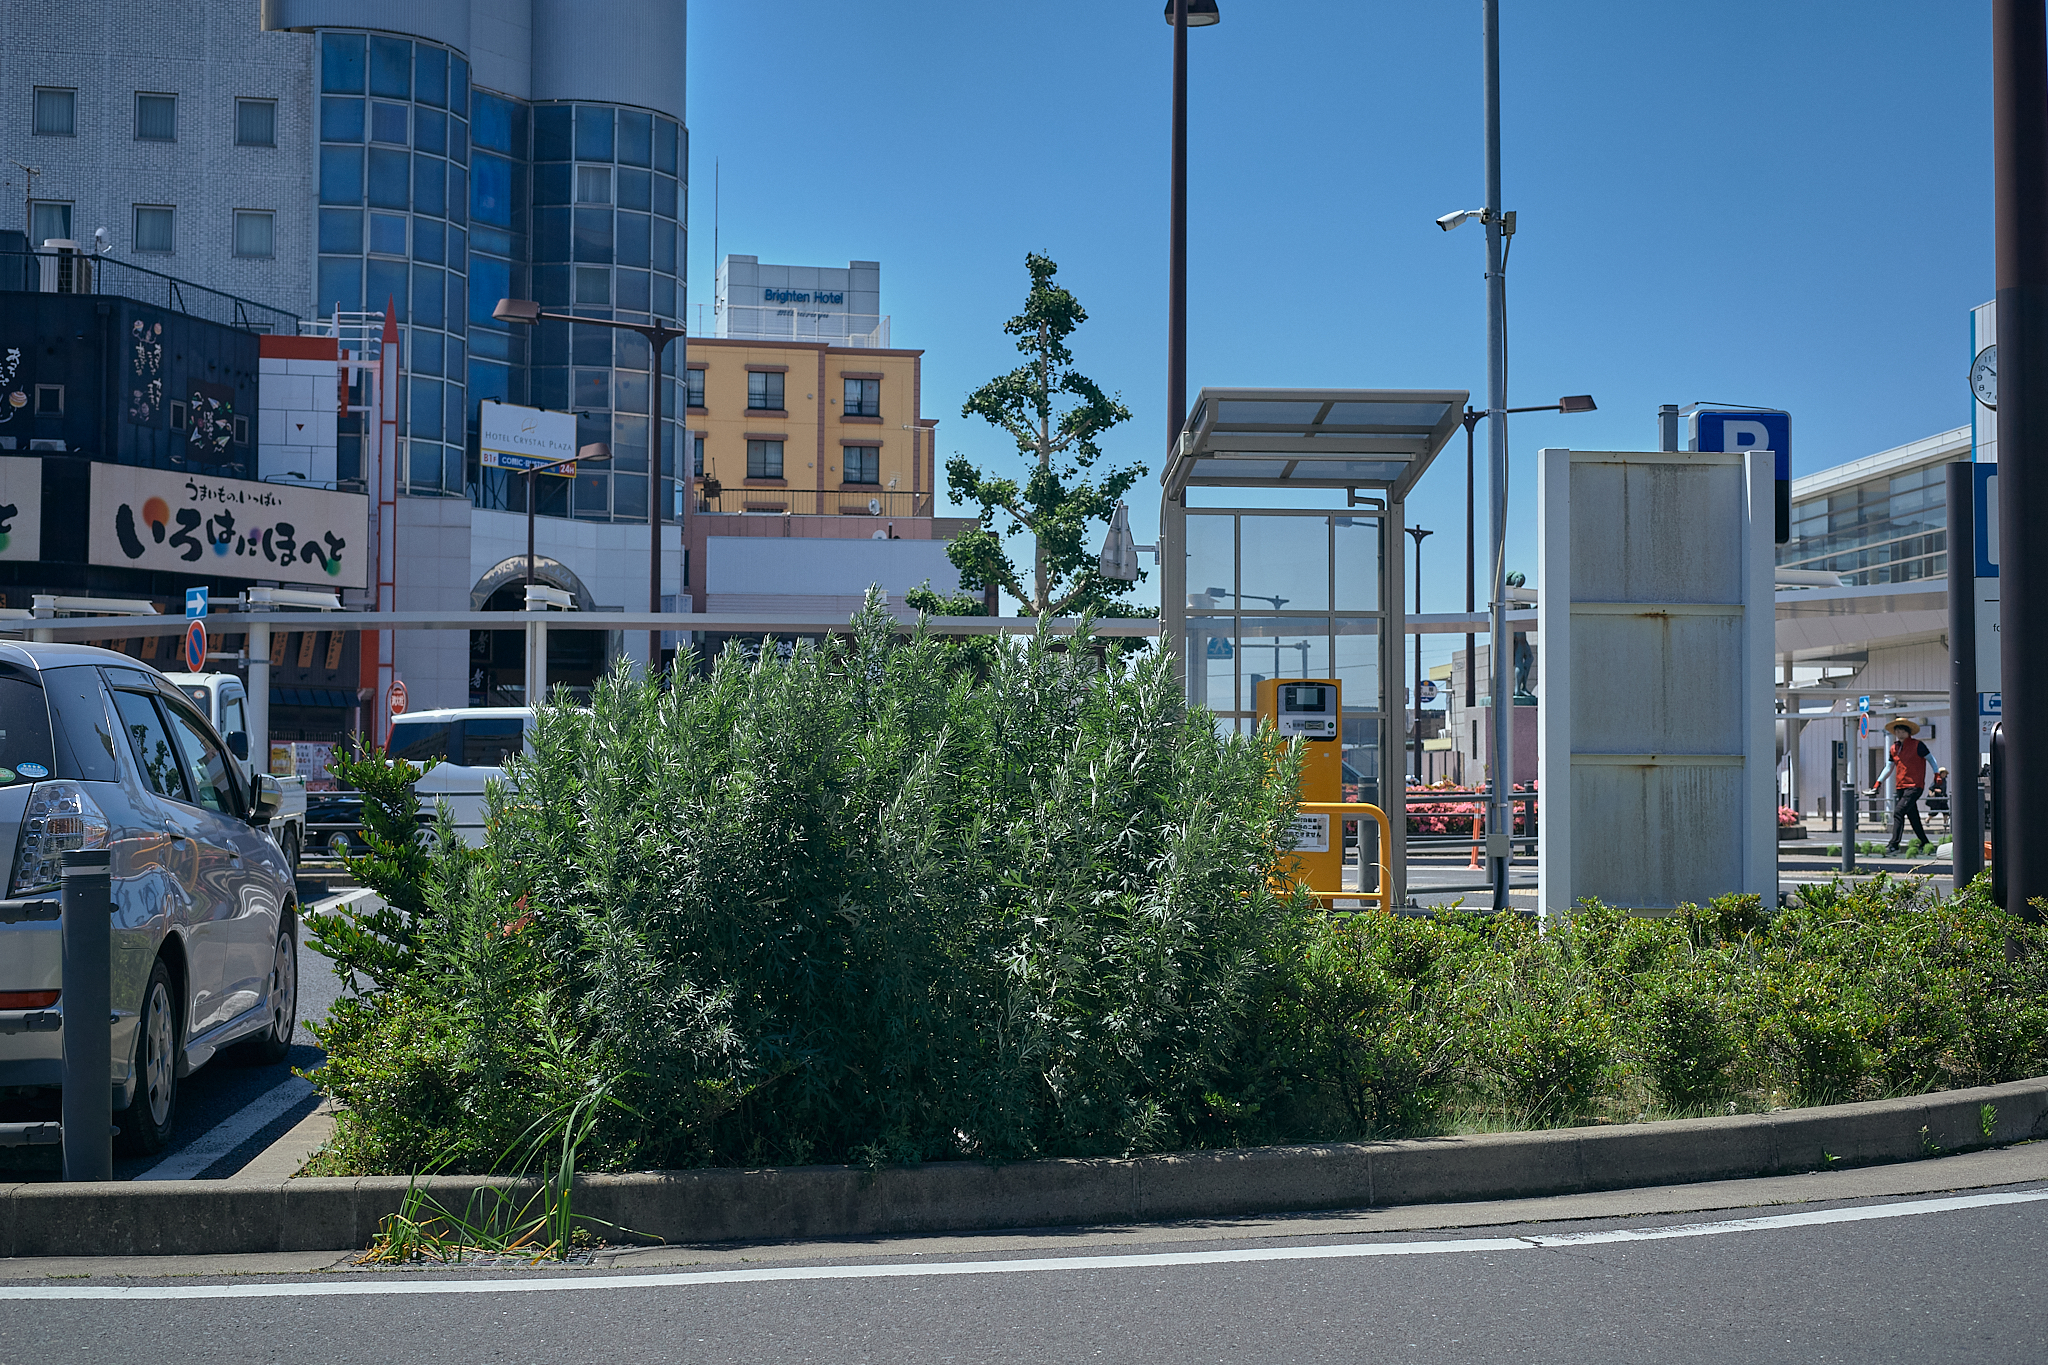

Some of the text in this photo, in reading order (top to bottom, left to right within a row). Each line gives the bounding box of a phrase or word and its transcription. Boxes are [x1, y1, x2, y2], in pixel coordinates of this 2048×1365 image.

[764, 288, 844, 304] Brighten Hotel
[1723, 420, 1769, 452] P
[483, 453, 497, 463] B1F
[560, 464, 575, 474] 24H
[115, 503, 346, 572] いろはにほへと
